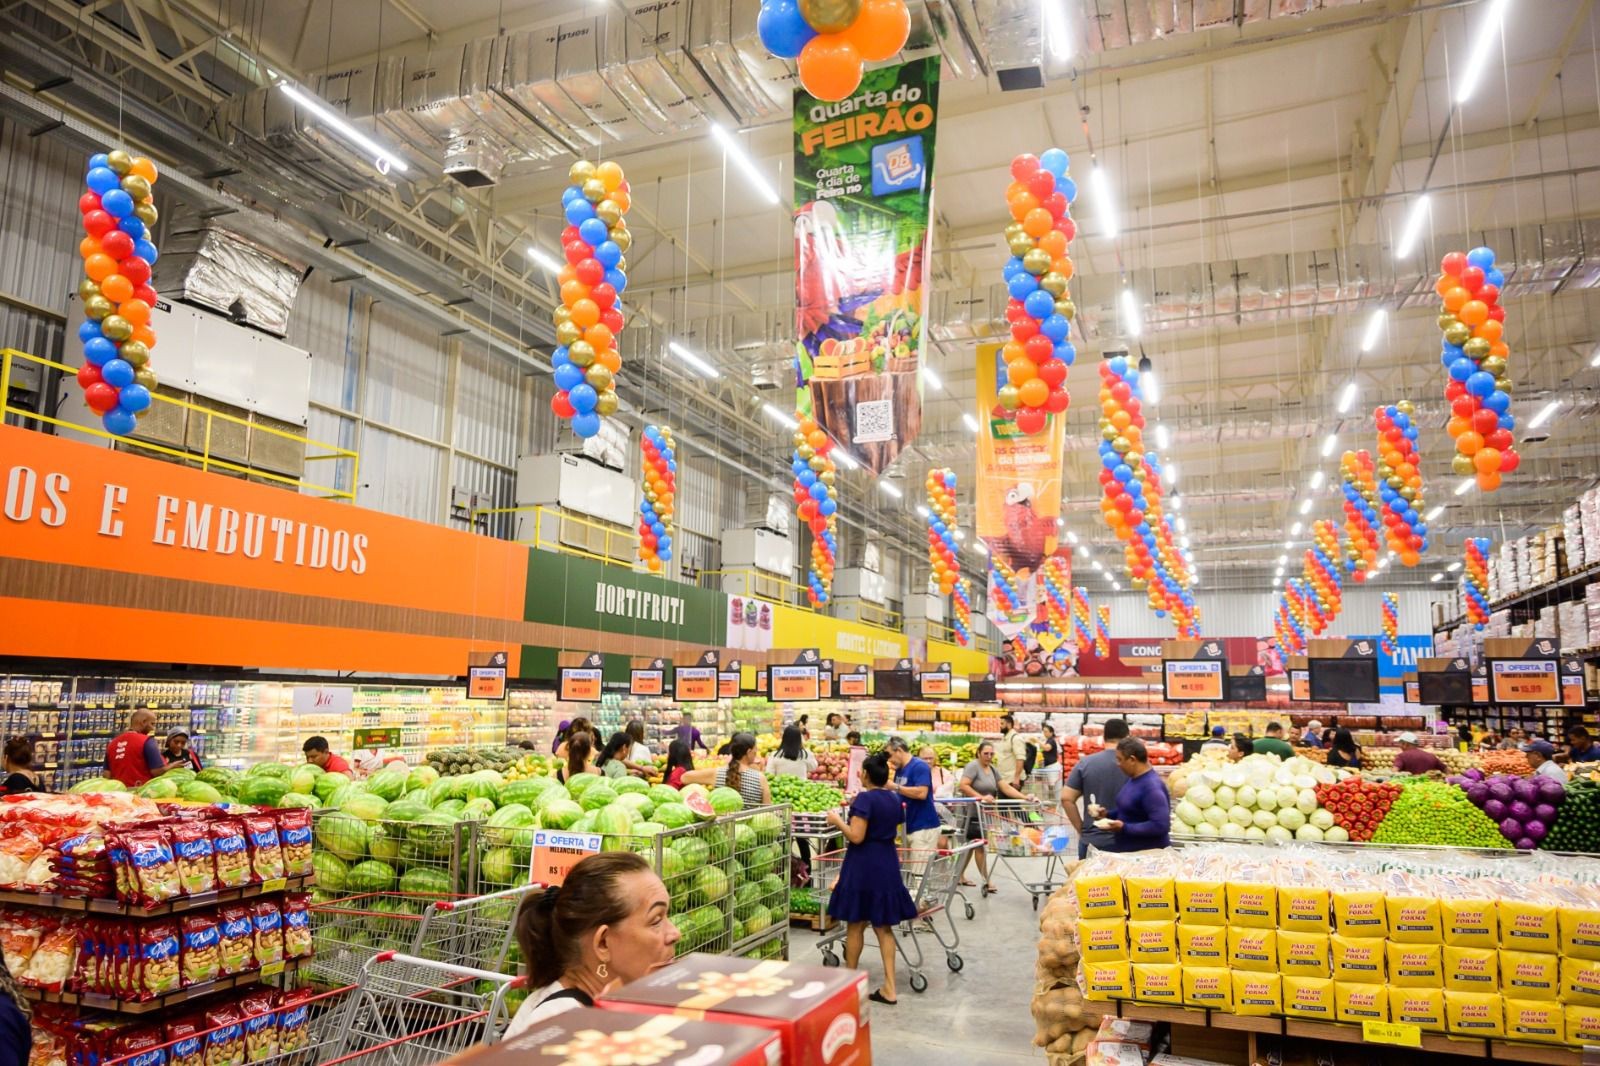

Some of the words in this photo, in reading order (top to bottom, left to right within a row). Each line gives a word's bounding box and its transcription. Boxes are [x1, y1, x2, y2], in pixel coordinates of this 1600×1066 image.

[810, 90, 887, 123] Quarta
[892, 84, 921, 102] do
[802, 101, 934, 156] FEIRÃO
[816, 165, 854, 179] Quarta
[816, 178, 824, 188] é
[825, 176, 843, 187] dia
[845, 173, 860, 183] de
[816, 187, 845, 200] Feira
[846, 183, 862, 194] no
[4, 466, 70, 526] OS
[98, 483, 128, 537] E
[152, 494, 368, 575] EMBUTIDOS
[595, 582, 685, 625] HORTIFRUTI
[550, 836, 584, 846] OFERTA
[549, 847, 575, 855] MELANCIA
[549, 866, 557, 874] R$
